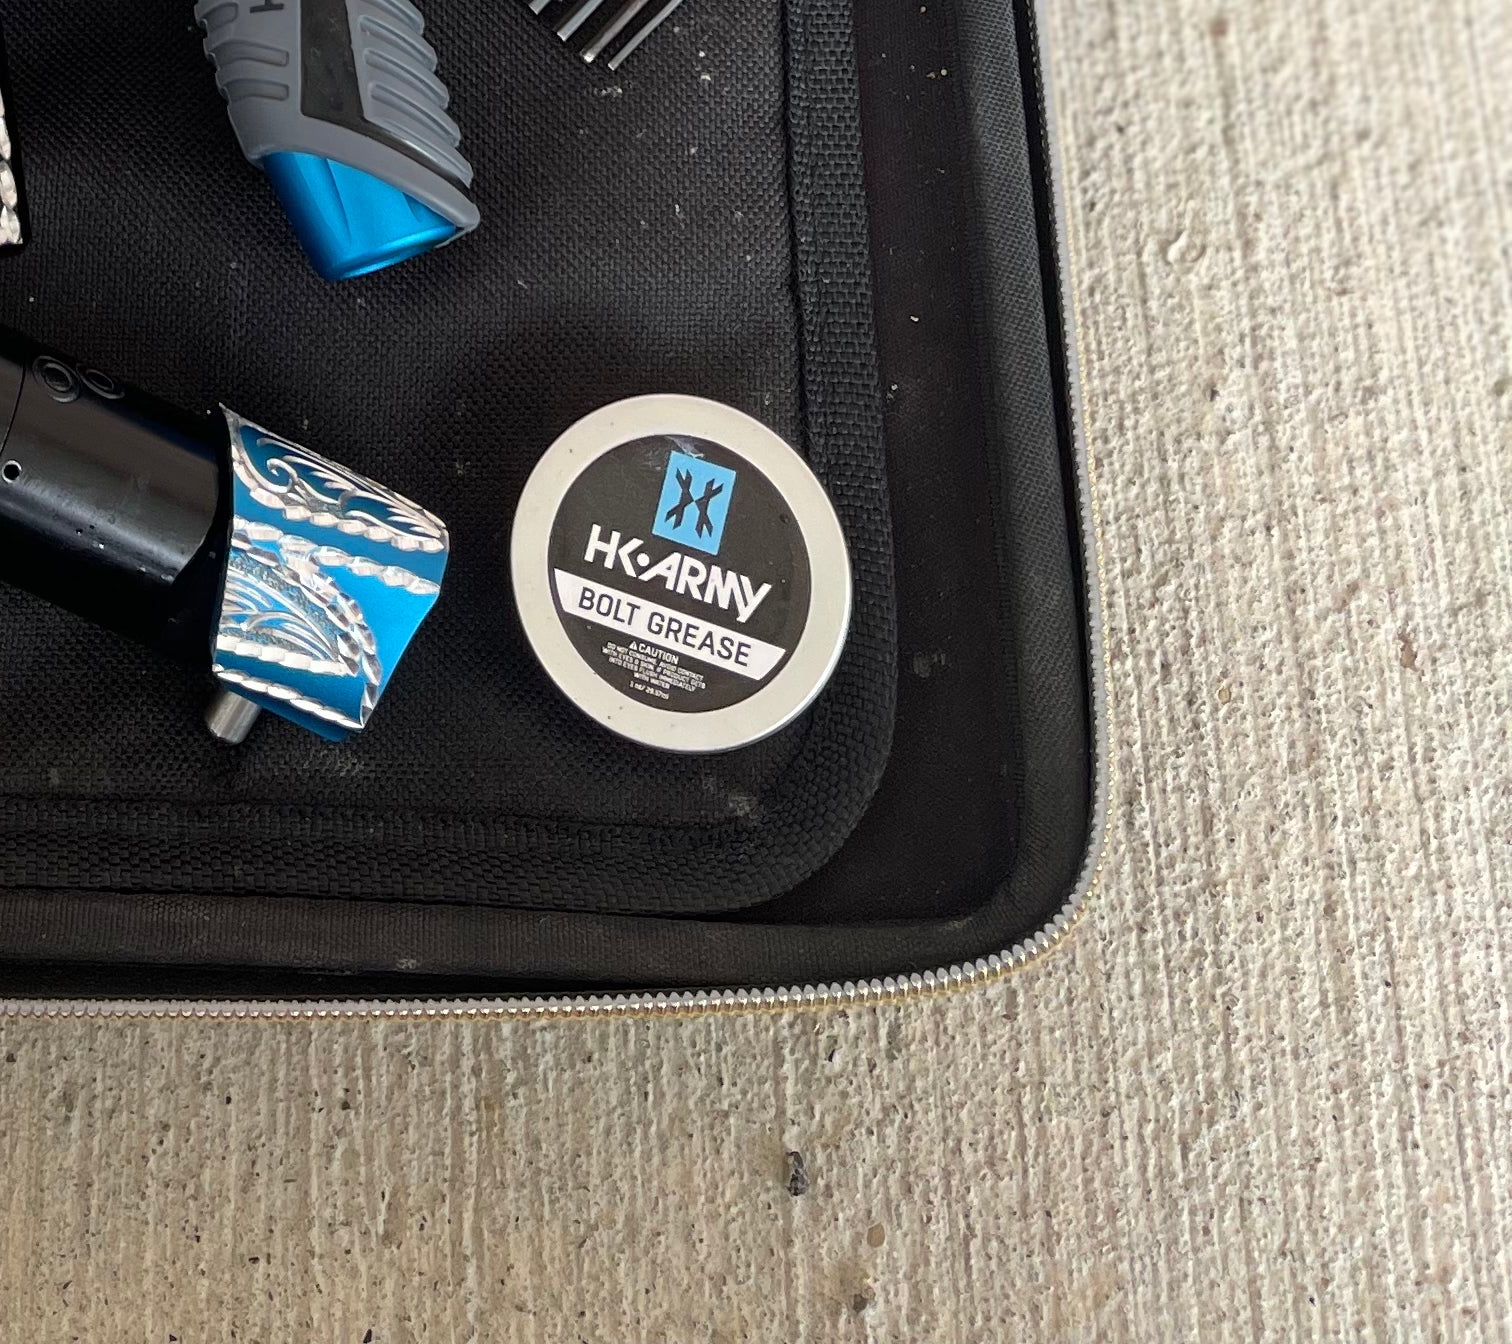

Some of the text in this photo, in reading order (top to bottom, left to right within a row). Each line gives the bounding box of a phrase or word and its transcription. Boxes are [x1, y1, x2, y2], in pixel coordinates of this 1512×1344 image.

[577, 585, 752, 668] BOLT GREASE
[637, 642, 679, 665] CAUTION
